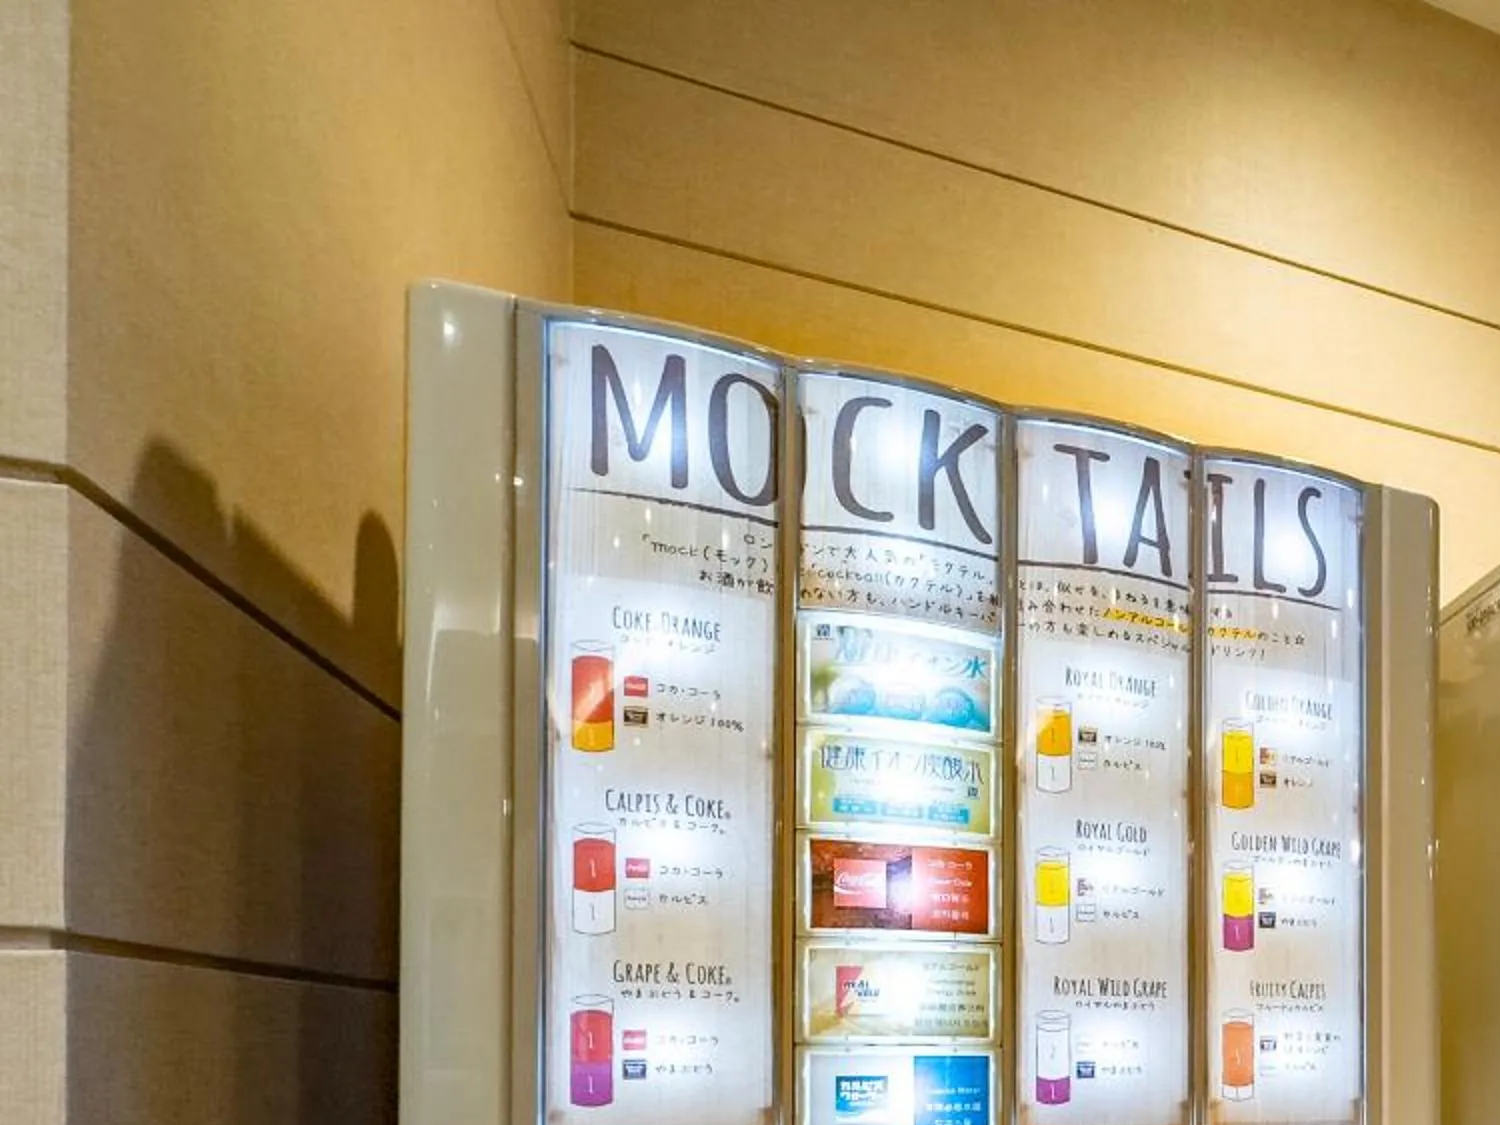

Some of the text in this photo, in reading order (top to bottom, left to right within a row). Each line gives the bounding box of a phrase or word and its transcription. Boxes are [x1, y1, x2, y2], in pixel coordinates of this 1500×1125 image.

[590, 343, 1327, 598] MOCK TAILS
[605, 788, 660, 815] CALPIS
[1075, 818, 1148, 843] ROYAL GOLD
[1231, 831, 1277, 853] GOLDEN
[1280, 834, 1310, 856] WILD
[613, 959, 661, 984] GRAPE
[1053, 975, 1168, 999] ROYAL WILD GRAPE
